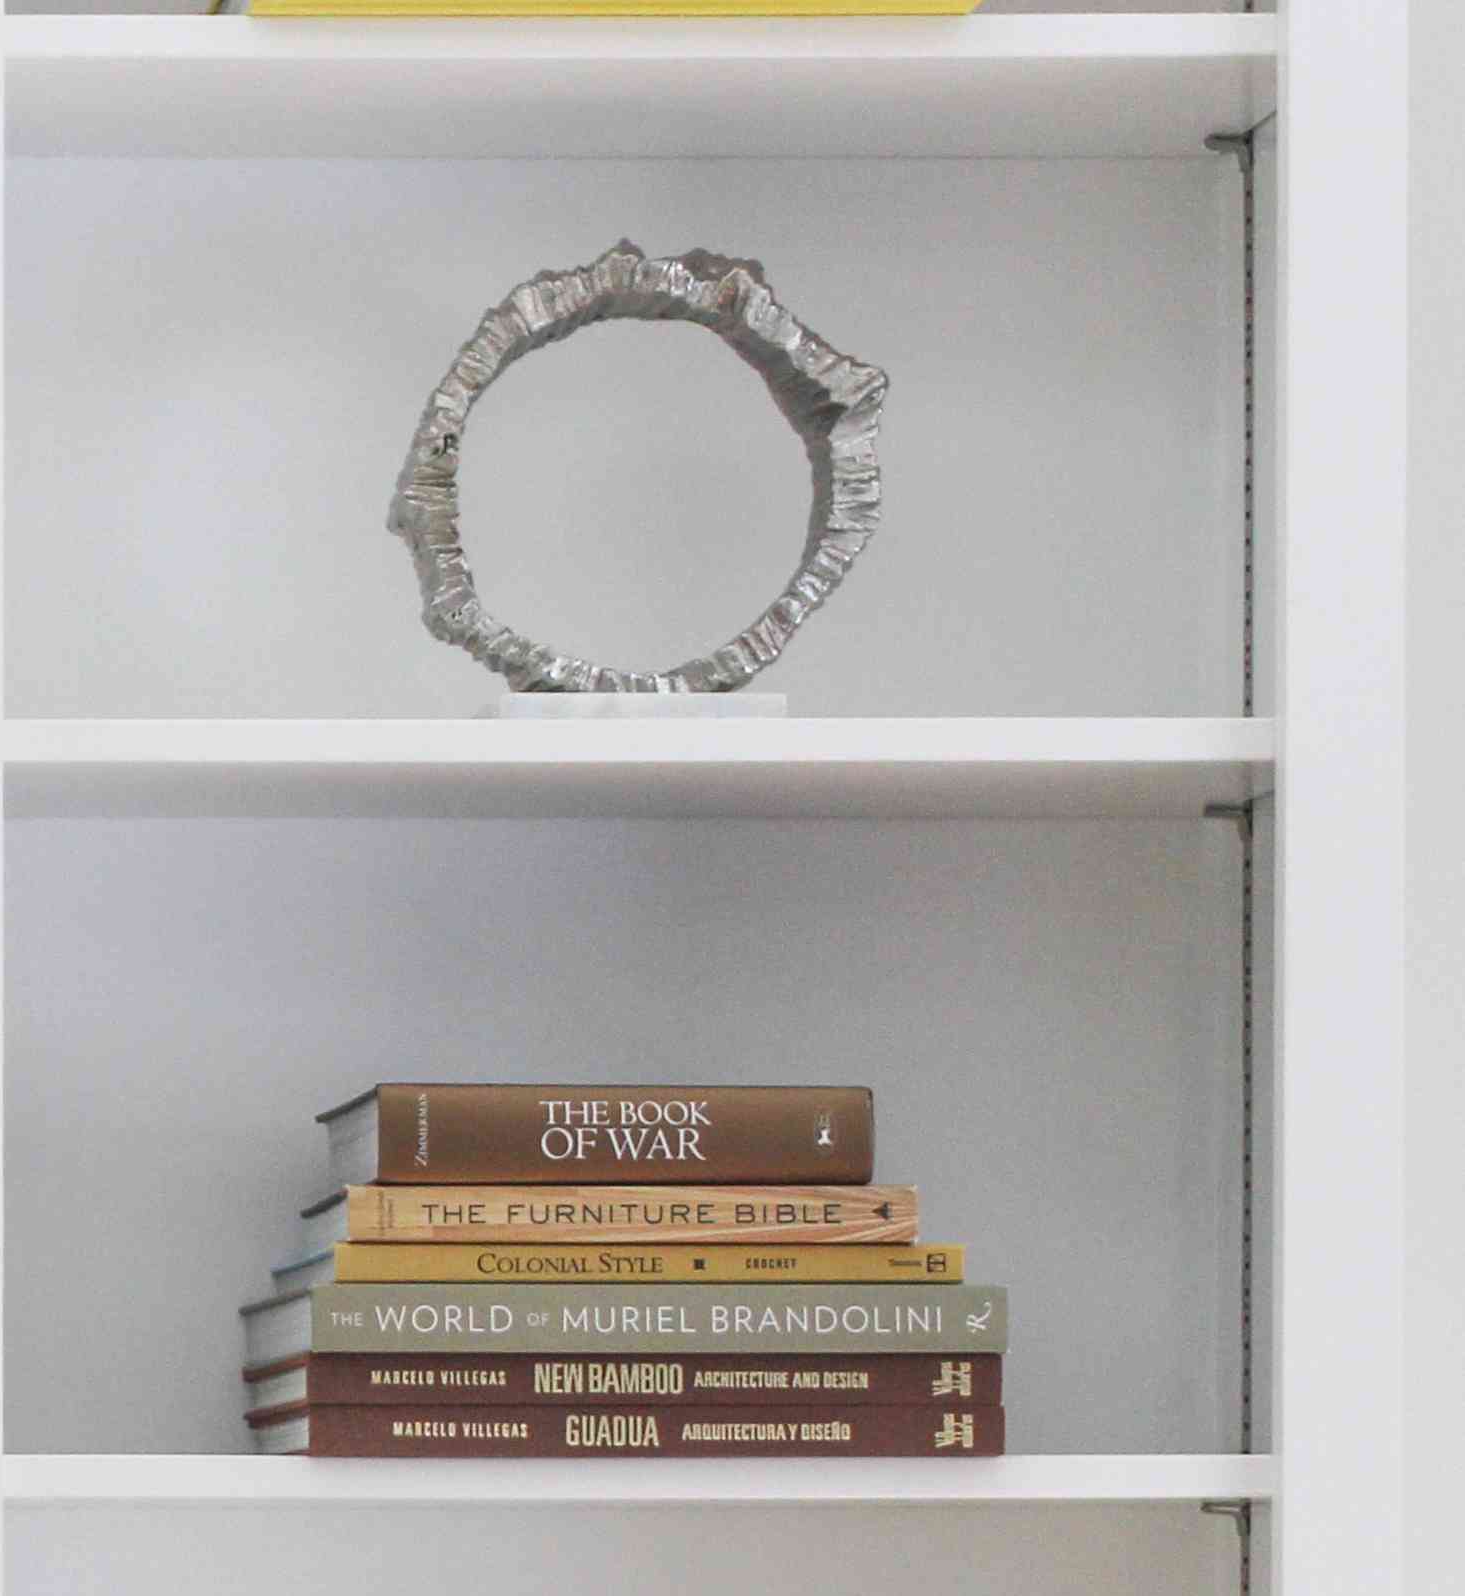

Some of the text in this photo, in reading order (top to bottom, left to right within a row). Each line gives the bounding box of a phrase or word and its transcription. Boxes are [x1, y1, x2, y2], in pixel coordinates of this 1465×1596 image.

[539, 1100, 711, 1125] THE BOOK
[540, 1128, 707, 1161] OF WAR
[422, 1204, 842, 1224] THE FURNITURE BIBLE
[476, 1253, 663, 1274] COLONIAL STYLE
[331, 1305, 942, 1334] THE WORLD OF MURIEL BRANDOLINI
[371, 1363, 868, 1395] MARCELO VILLEGAS NEW BAMBOO ARCHITECTURE AND DESIGN
[393, 1415, 851, 1447] MARCELO VILLEGAS GUADUA ARQUITECTURA Y DISEÑO
